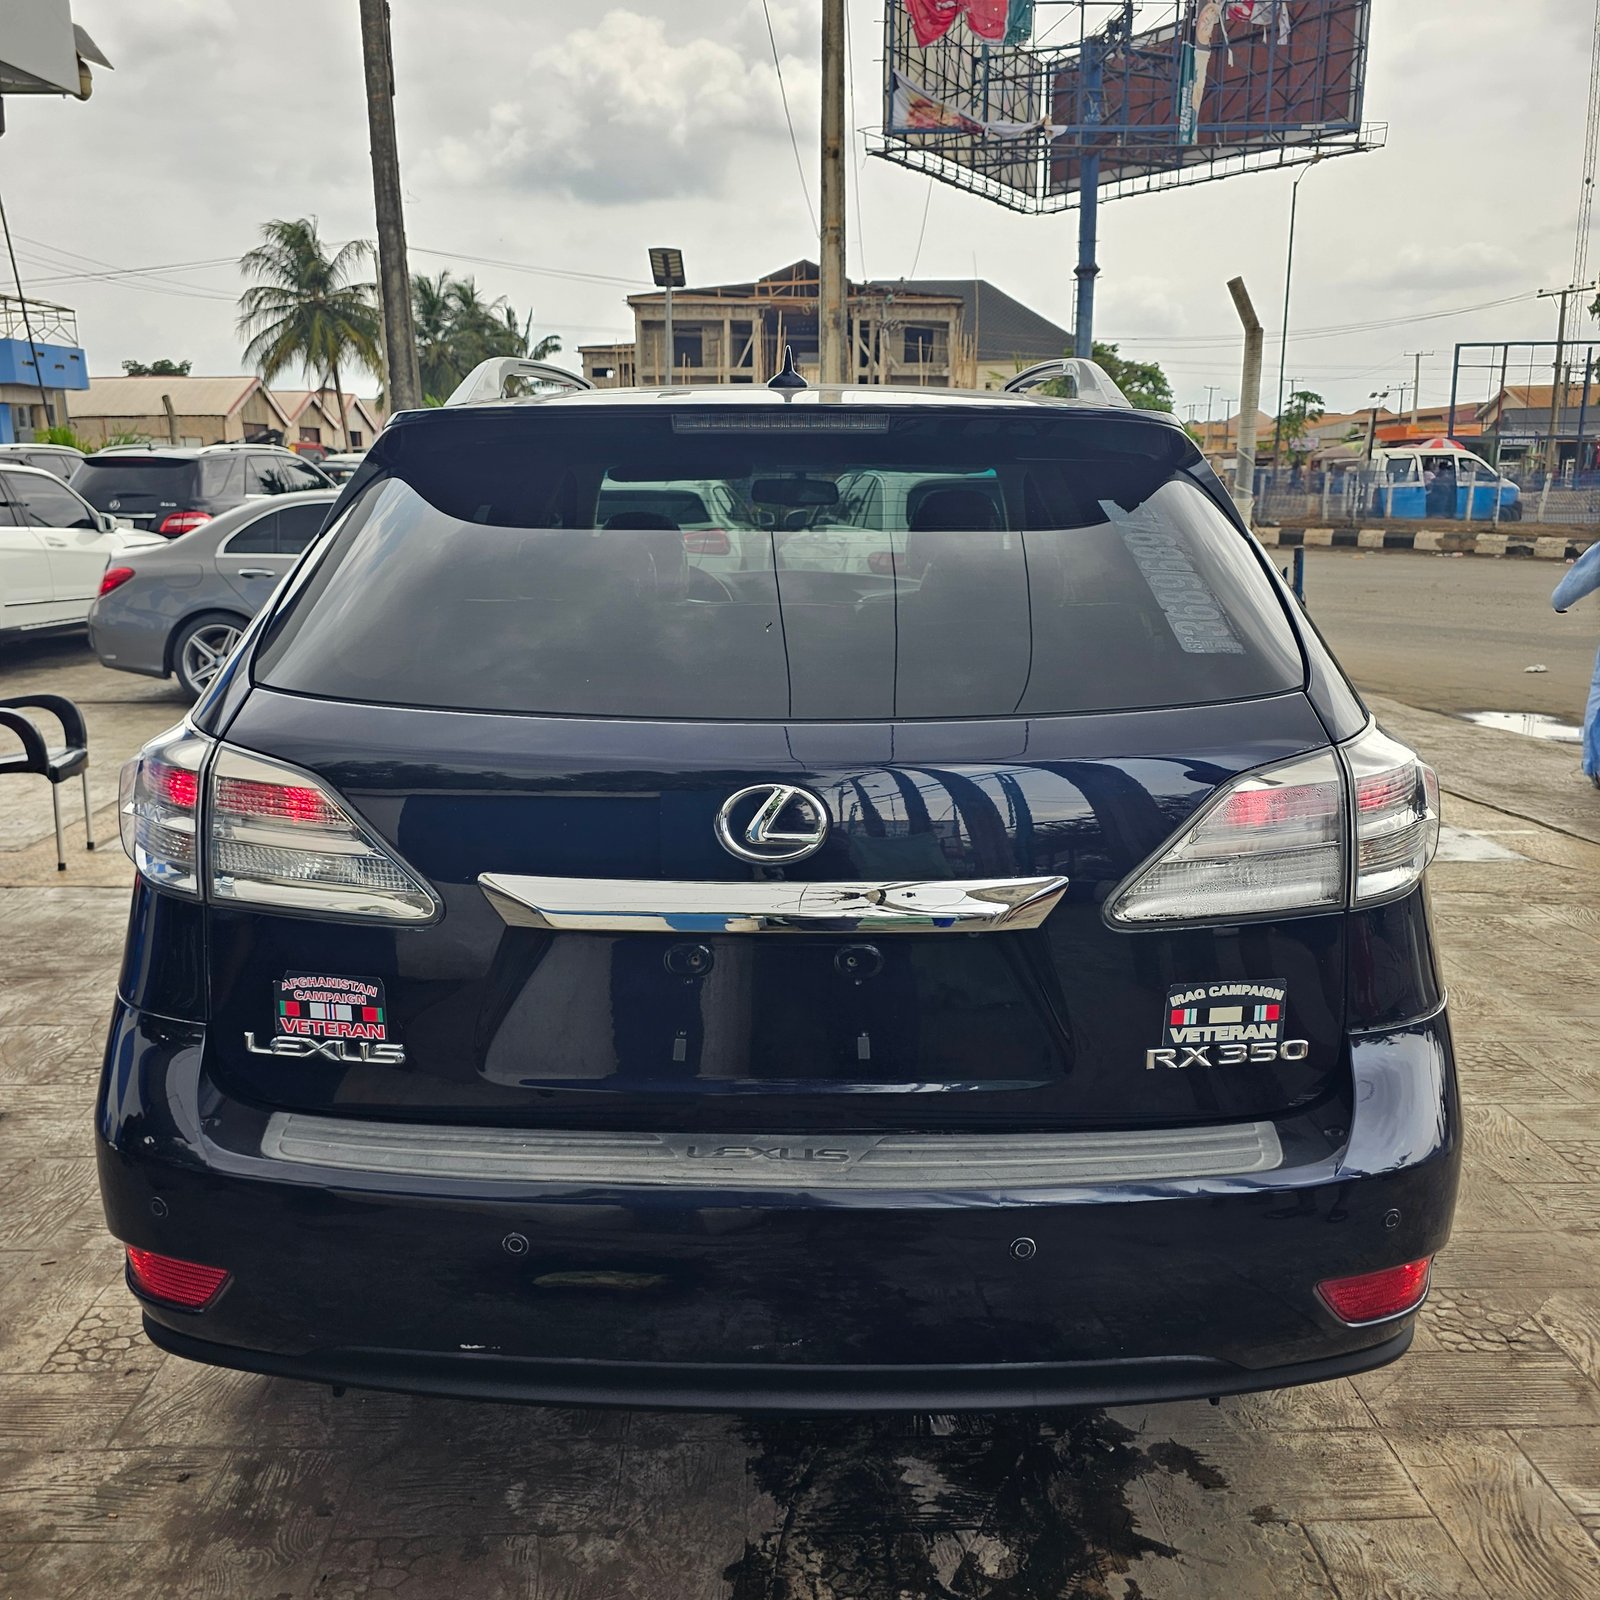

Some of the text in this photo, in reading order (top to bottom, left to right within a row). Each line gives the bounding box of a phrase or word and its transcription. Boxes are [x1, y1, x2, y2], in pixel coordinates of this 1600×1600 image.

[281, 976, 378, 998] AFGHANISTAN
[293, 989, 367, 1005] CAMPAIGN
[1169, 984, 1285, 1007] IRAQ CAMPAIGN
[279, 1017, 386, 1040] VETERAN
[1169, 1023, 1278, 1044] VETERAN
[244, 1032, 406, 1064] LEXUS
[1146, 1038, 1309, 1070] RX 350
[687, 1145, 850, 1162] LEXUS
